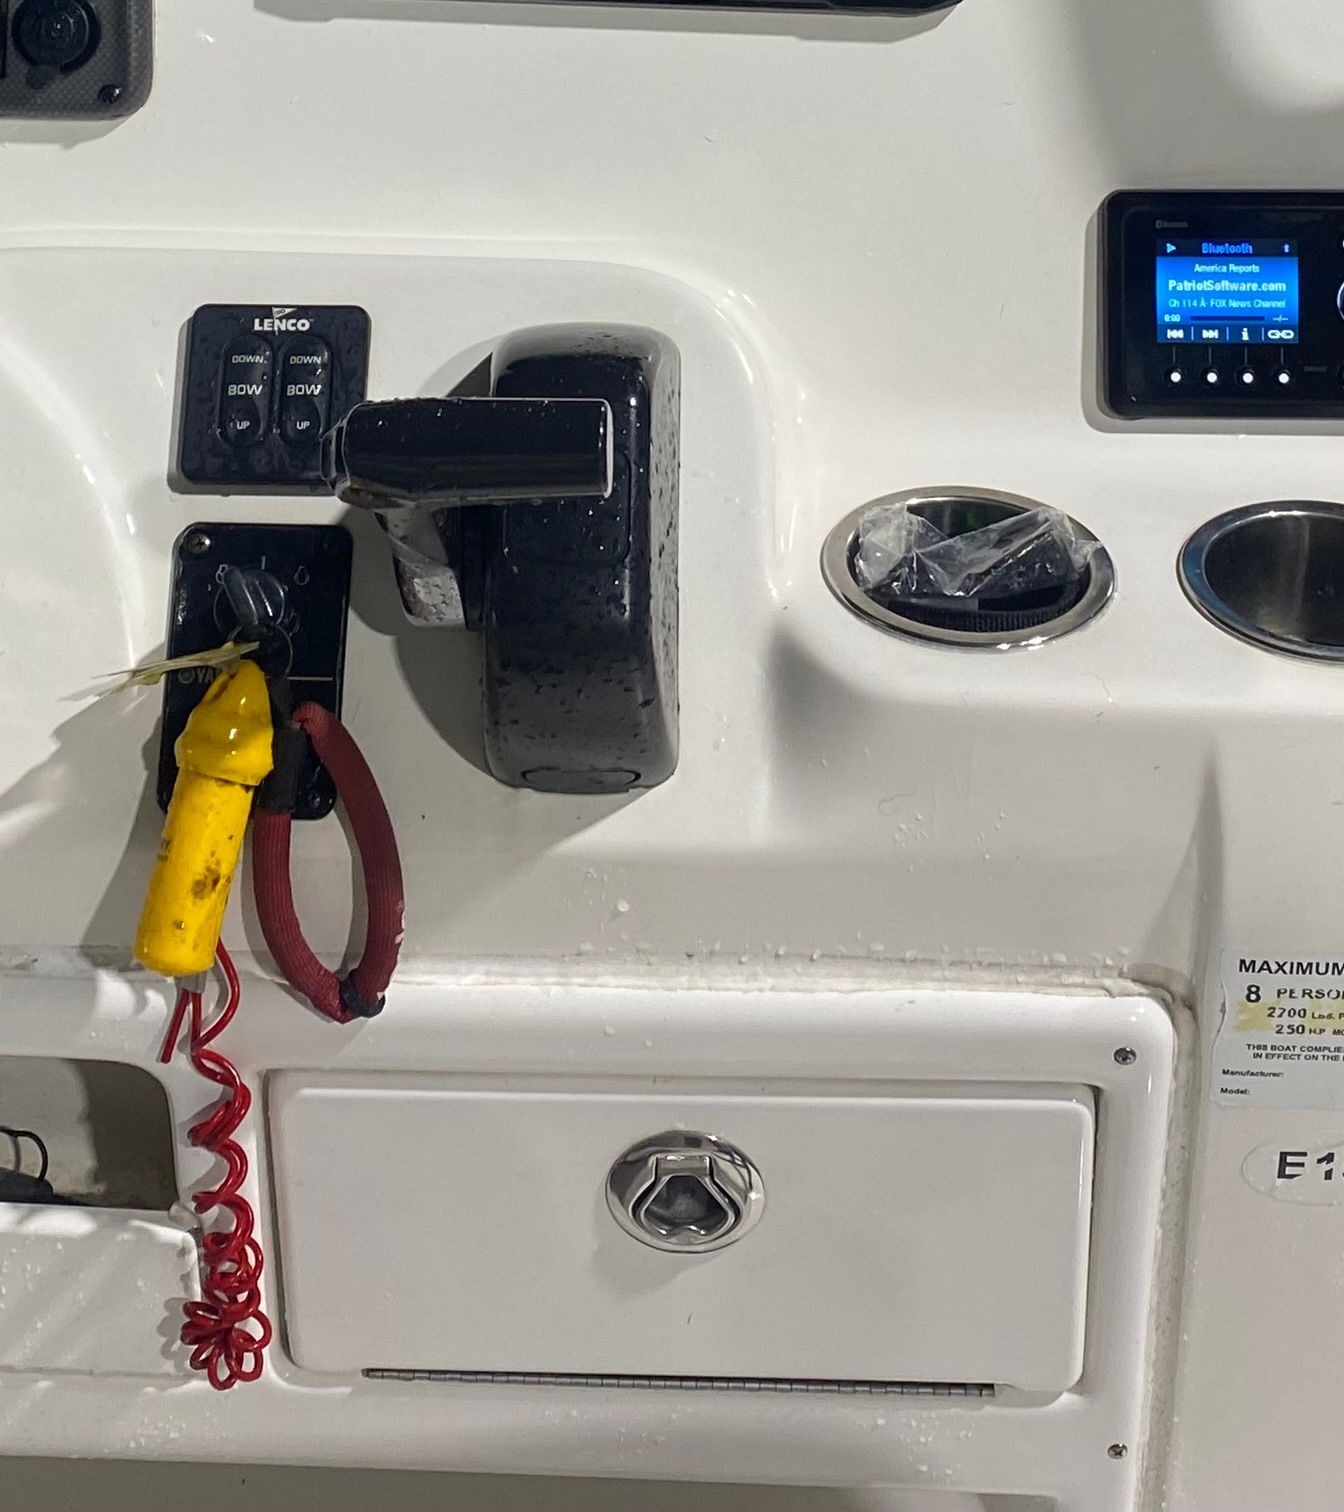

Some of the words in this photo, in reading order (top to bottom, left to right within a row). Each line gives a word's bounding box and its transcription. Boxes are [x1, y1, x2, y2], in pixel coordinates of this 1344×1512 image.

[1202, 243, 1253, 254] Bluetooth
[1194, 264, 1227, 273] America
[1229, 264, 1260, 274] Reports
[1168, 280, 1287, 292] PatriotSoftware.com
[1210, 299, 1227, 308] FOX
[1229, 299, 1251, 308] News
[1253, 299, 1286, 308] Channel
[254, 318, 310, 331] LENCO
[232, 355, 263, 364] DOWN
[290, 356, 321, 365] DOWN
[228, 384, 263, 396] BOW
[286, 384, 322, 396] BOW
[236, 421, 250, 430] UP
[296, 421, 310, 430] UP
[1245, 984, 1262, 1003] 8
[1267, 1006, 1307, 1019] 2700
[1275, 1024, 1306, 1035] 250
[1246, 1043, 1268, 1051] THIS
[1270, 1044, 1297, 1052] BOAT
[1265, 1052, 1301, 1061] EFFECT
[1321, 1054, 1340, 1062] THE
[1222, 1069, 1284, 1078] Manufacturer:
[1220, 1087, 1250, 1096] Model:
